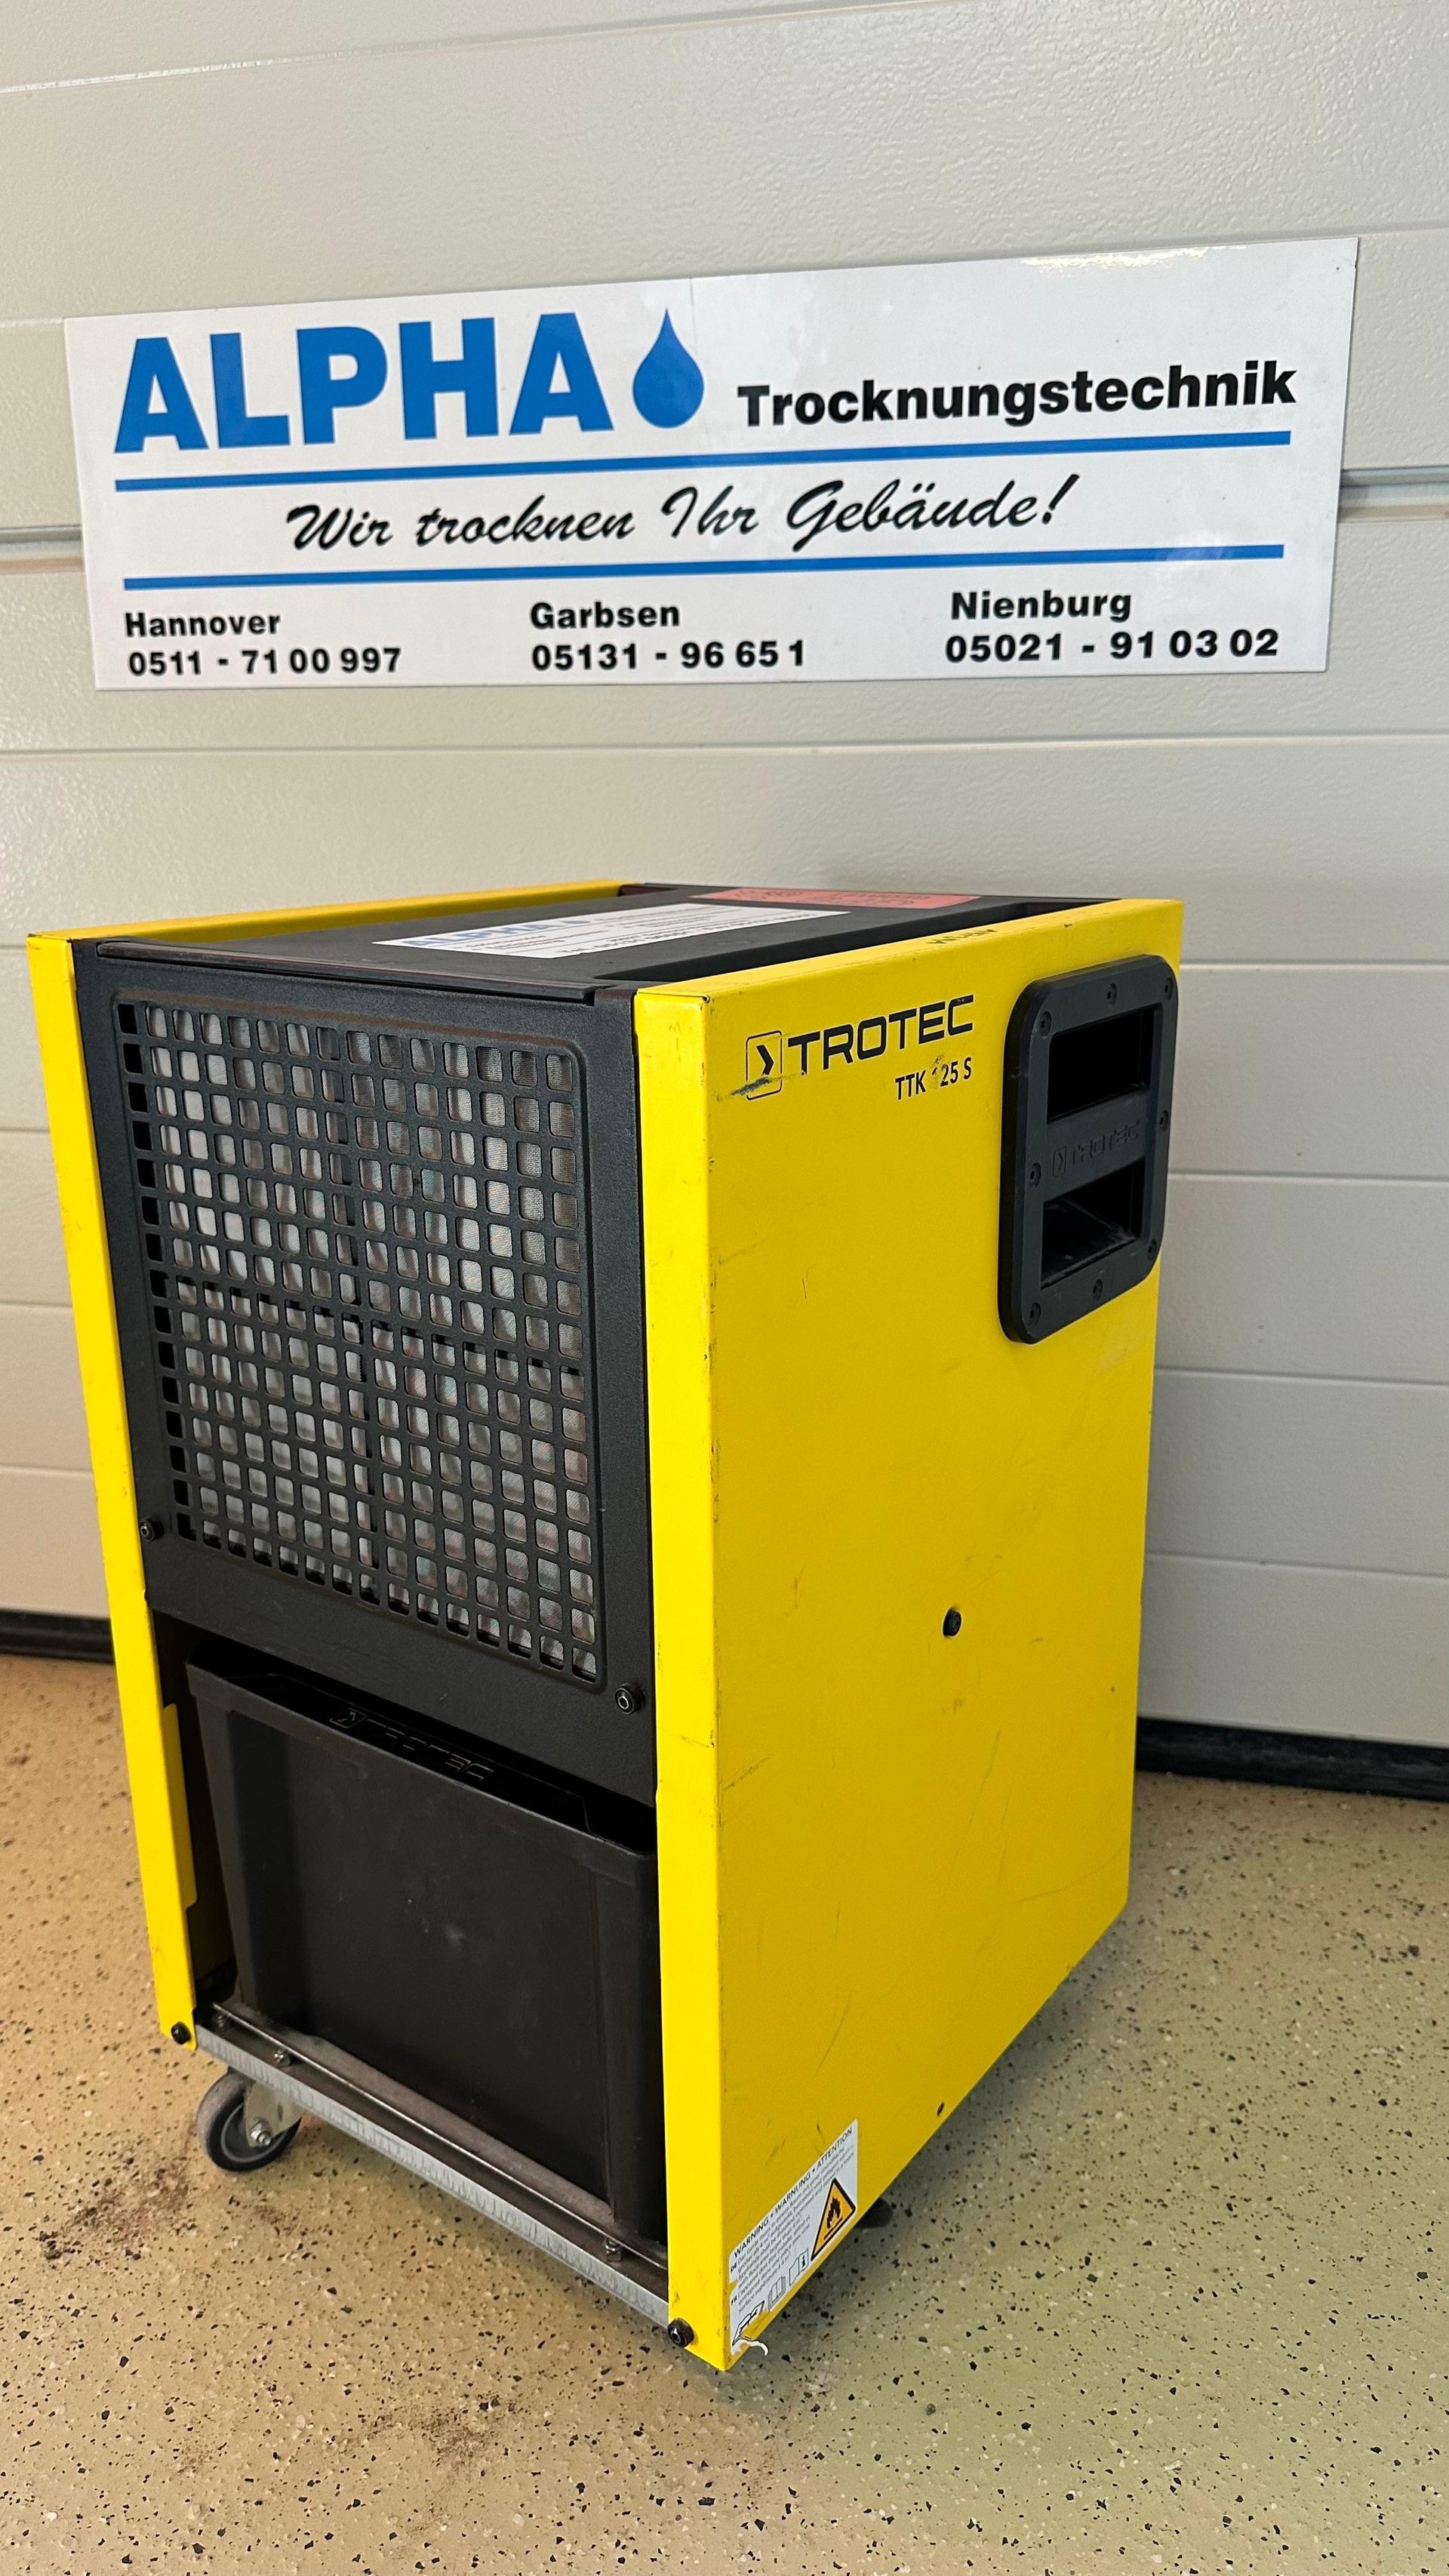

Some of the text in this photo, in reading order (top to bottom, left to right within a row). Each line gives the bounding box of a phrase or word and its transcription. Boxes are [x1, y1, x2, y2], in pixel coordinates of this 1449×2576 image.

[114, 312, 614, 454] ALPHA
[737, 360, 1297, 427] Trocknungstechnik
[286, 473, 1080, 552] Wir trocknen Ihr Gebäude!
[531, 601, 679, 629] Garbsen
[952, 589, 1131, 623] Nienburg
[125, 612, 280, 638] Hannover
[129, 651, 201, 676] 0511
[340, 647, 401, 673] 997
[532, 643, 636, 671] 05131
[946, 633, 1061, 663] 05021
[787, 994, 974, 1075] TROTEC
[894, 1069, 927, 1100] TTK
[963, 1057, 972, 1080] S
[734, 2126, 851, 2257] WARNING WARNUNG ATTENTION
[731, 2295, 737, 2305] FR
